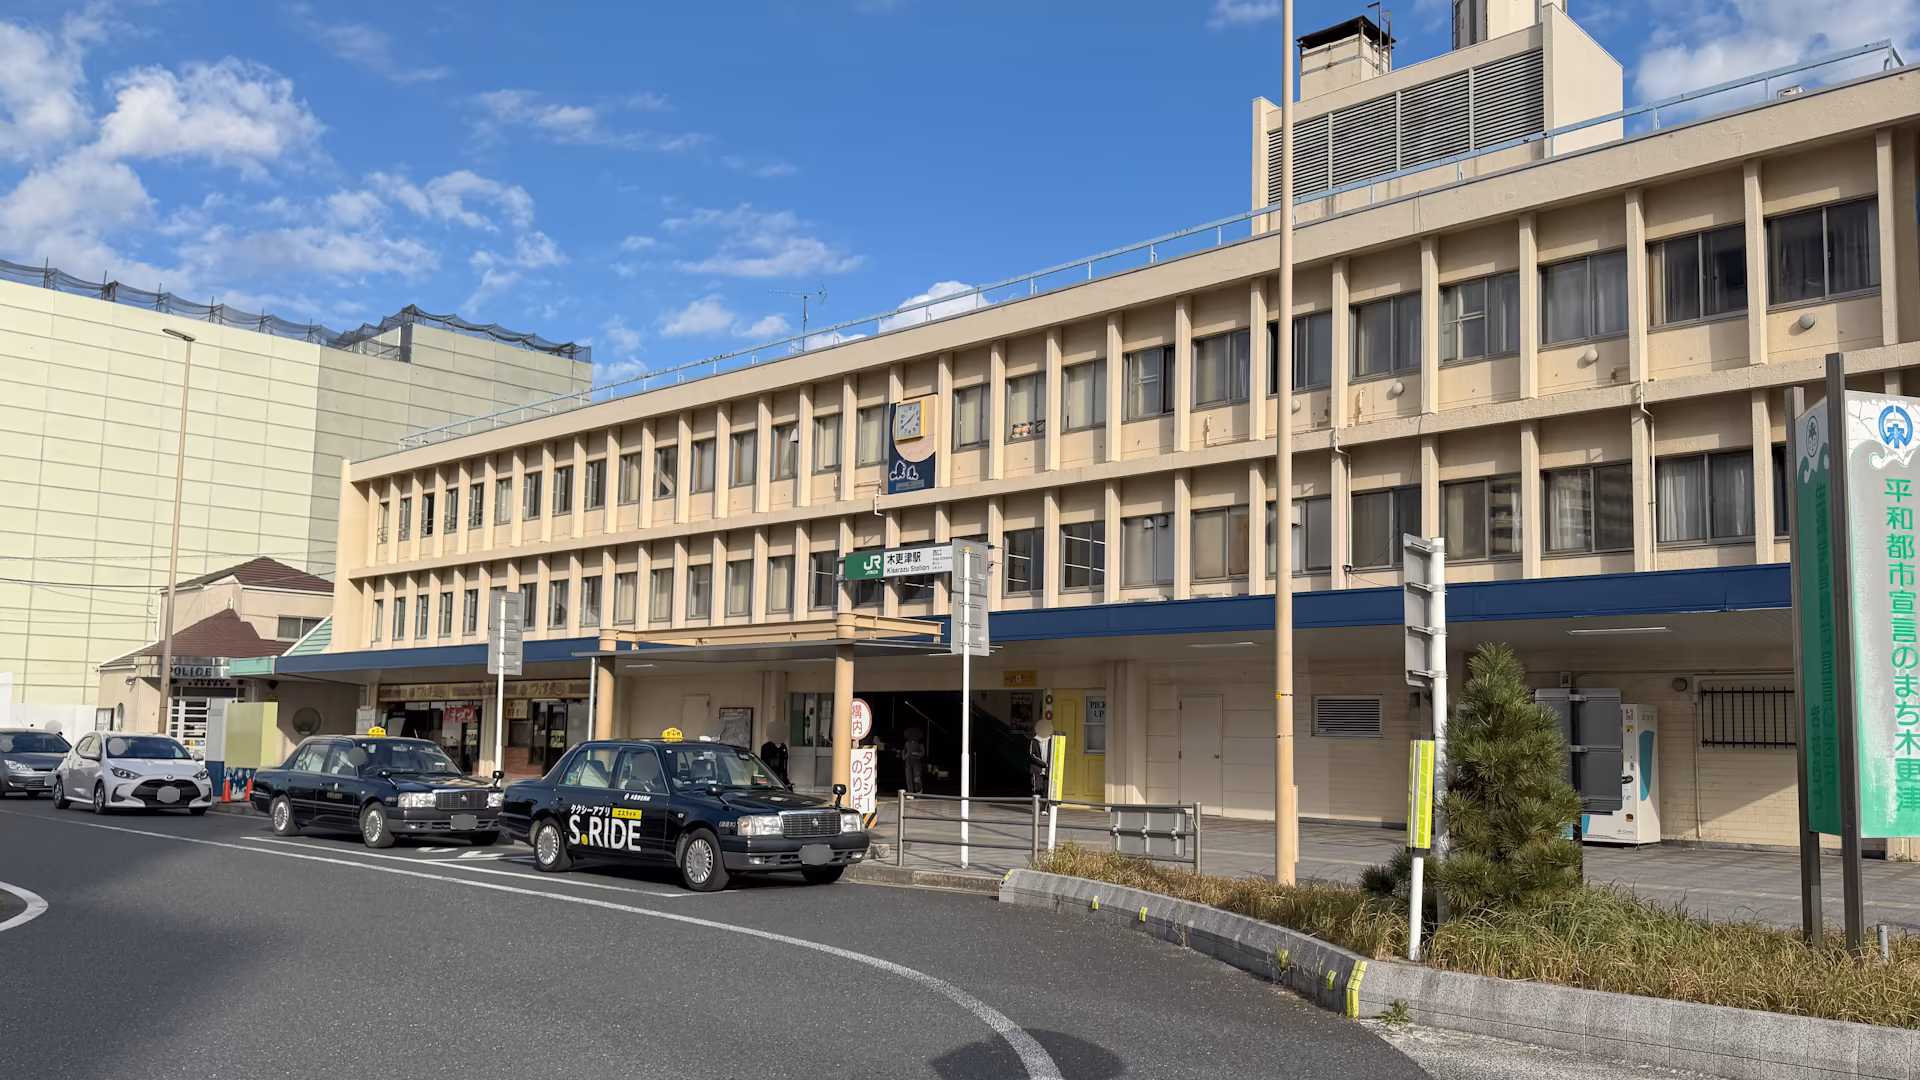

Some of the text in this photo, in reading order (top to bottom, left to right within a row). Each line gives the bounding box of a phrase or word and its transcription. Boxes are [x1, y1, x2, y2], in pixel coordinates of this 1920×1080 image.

[864, 554, 881, 570] JR
[887, 552, 921, 565] 木更津駅
[910, 564, 930, 572] Station
[1884, 478, 1920, 812] 平和都市宣言のまち木更津
[852, 704, 862, 734] 構内
[852, 760, 862, 809] のりば
[862, 752, 873, 812] タクシー
[570, 804, 610, 817] タクシーアプリ
[568, 814, 642, 852] S.RIDE
